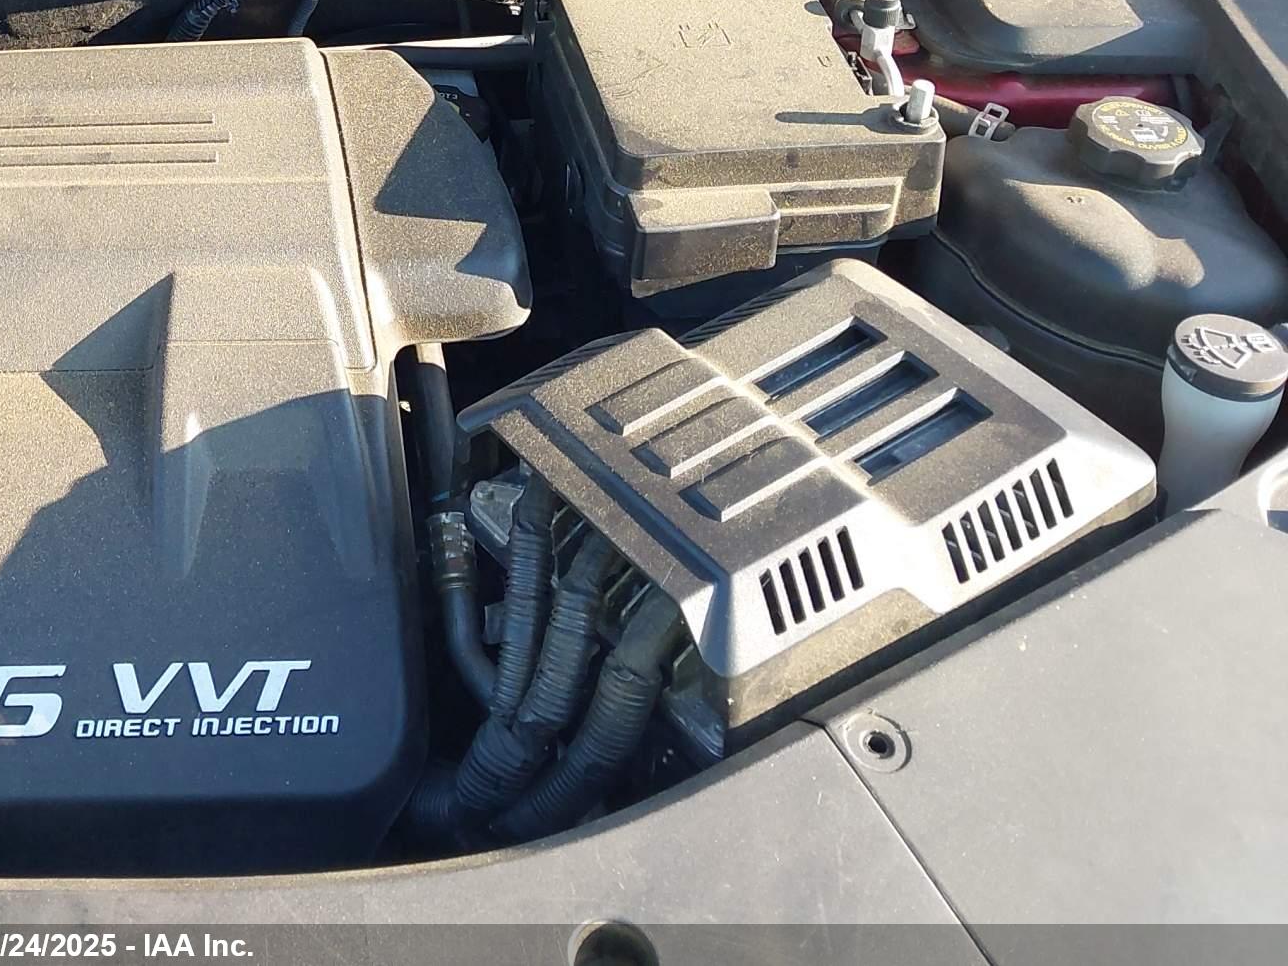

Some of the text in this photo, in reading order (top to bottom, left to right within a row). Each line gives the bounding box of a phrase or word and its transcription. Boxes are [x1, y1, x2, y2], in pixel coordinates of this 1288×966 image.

[113, 660, 312, 714] VVT
[76, 716, 340, 738] DIRECT INJECTION
